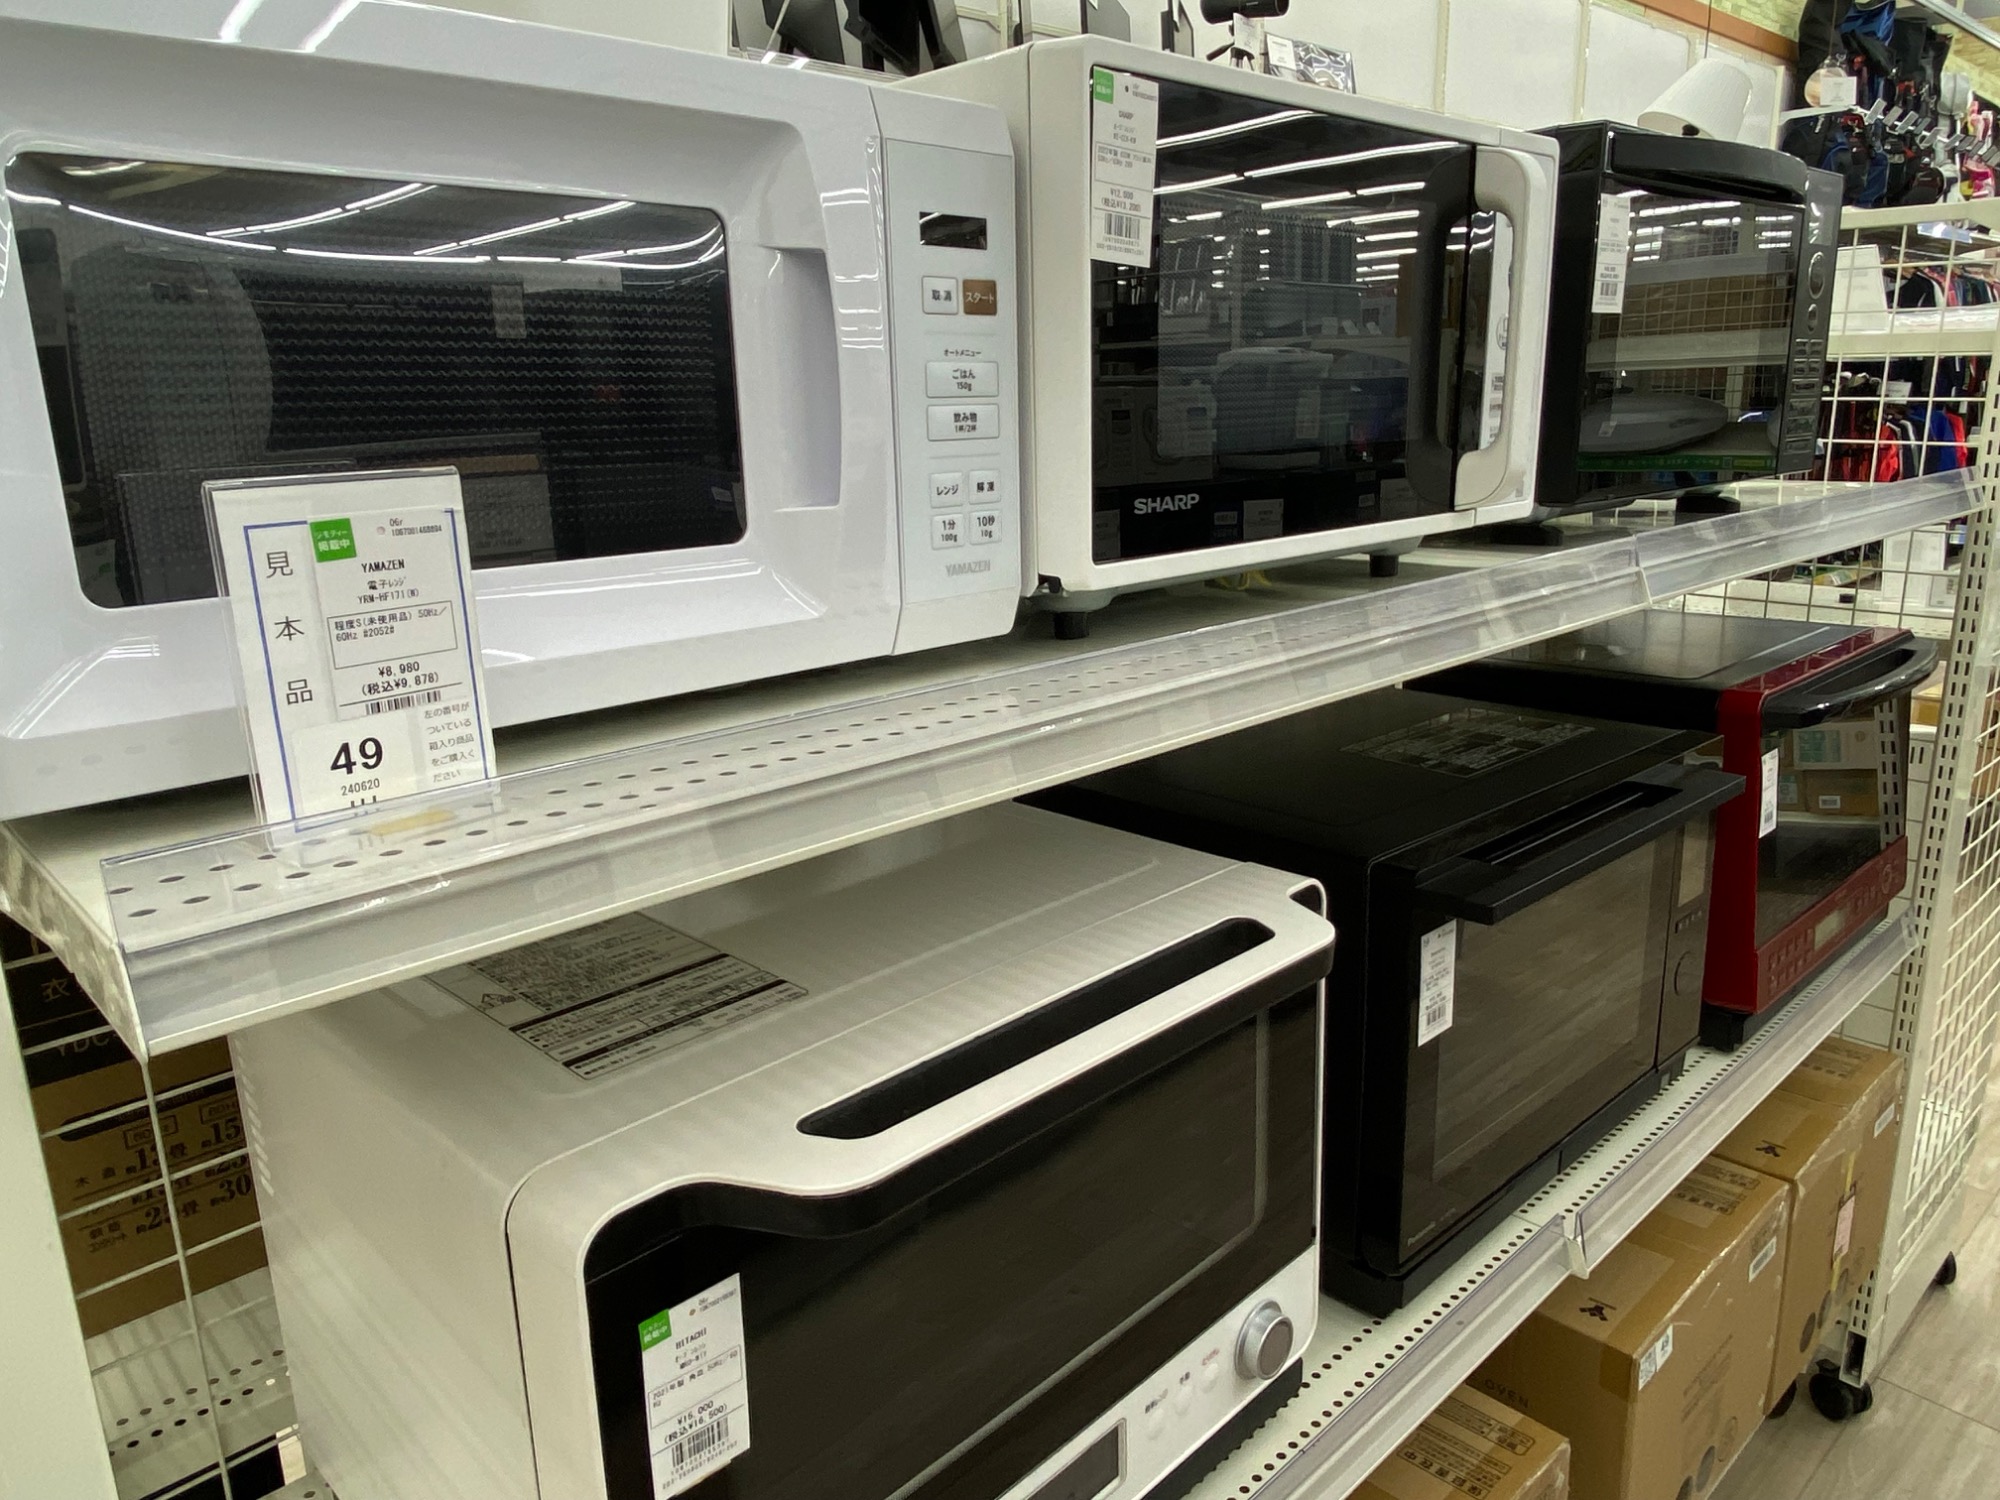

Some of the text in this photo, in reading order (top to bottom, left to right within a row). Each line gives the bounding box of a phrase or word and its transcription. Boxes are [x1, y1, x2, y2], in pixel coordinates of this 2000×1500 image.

[965, 291, 995, 305] スタート
[943, 348, 982, 357] オートメニュー
[952, 368, 976, 380] ごはん
[956, 381, 972, 392] 150g
[953, 412, 978, 423] 飲み物
[936, 484, 959, 496] レンジ
[1133, 493, 1200, 515] SHARP
[942, 519, 956, 531] 1分
[976, 515, 996, 527] 10秒
[941, 533, 958, 543] 100g
[980, 529, 993, 539] 10g
[361, 559, 406, 574] YAMAZEN
[945, 559, 991, 577] YAMAZEN
[335, 627, 358, 642] 60Hz
[424, 701, 471, 719] 左の番号が
[426, 718, 472, 735] ついている
[330, 737, 384, 776] 49
[432, 769, 461, 783] ださい
[341, 777, 381, 797] 240620
[675, 1327, 707, 1350] HITACHI
